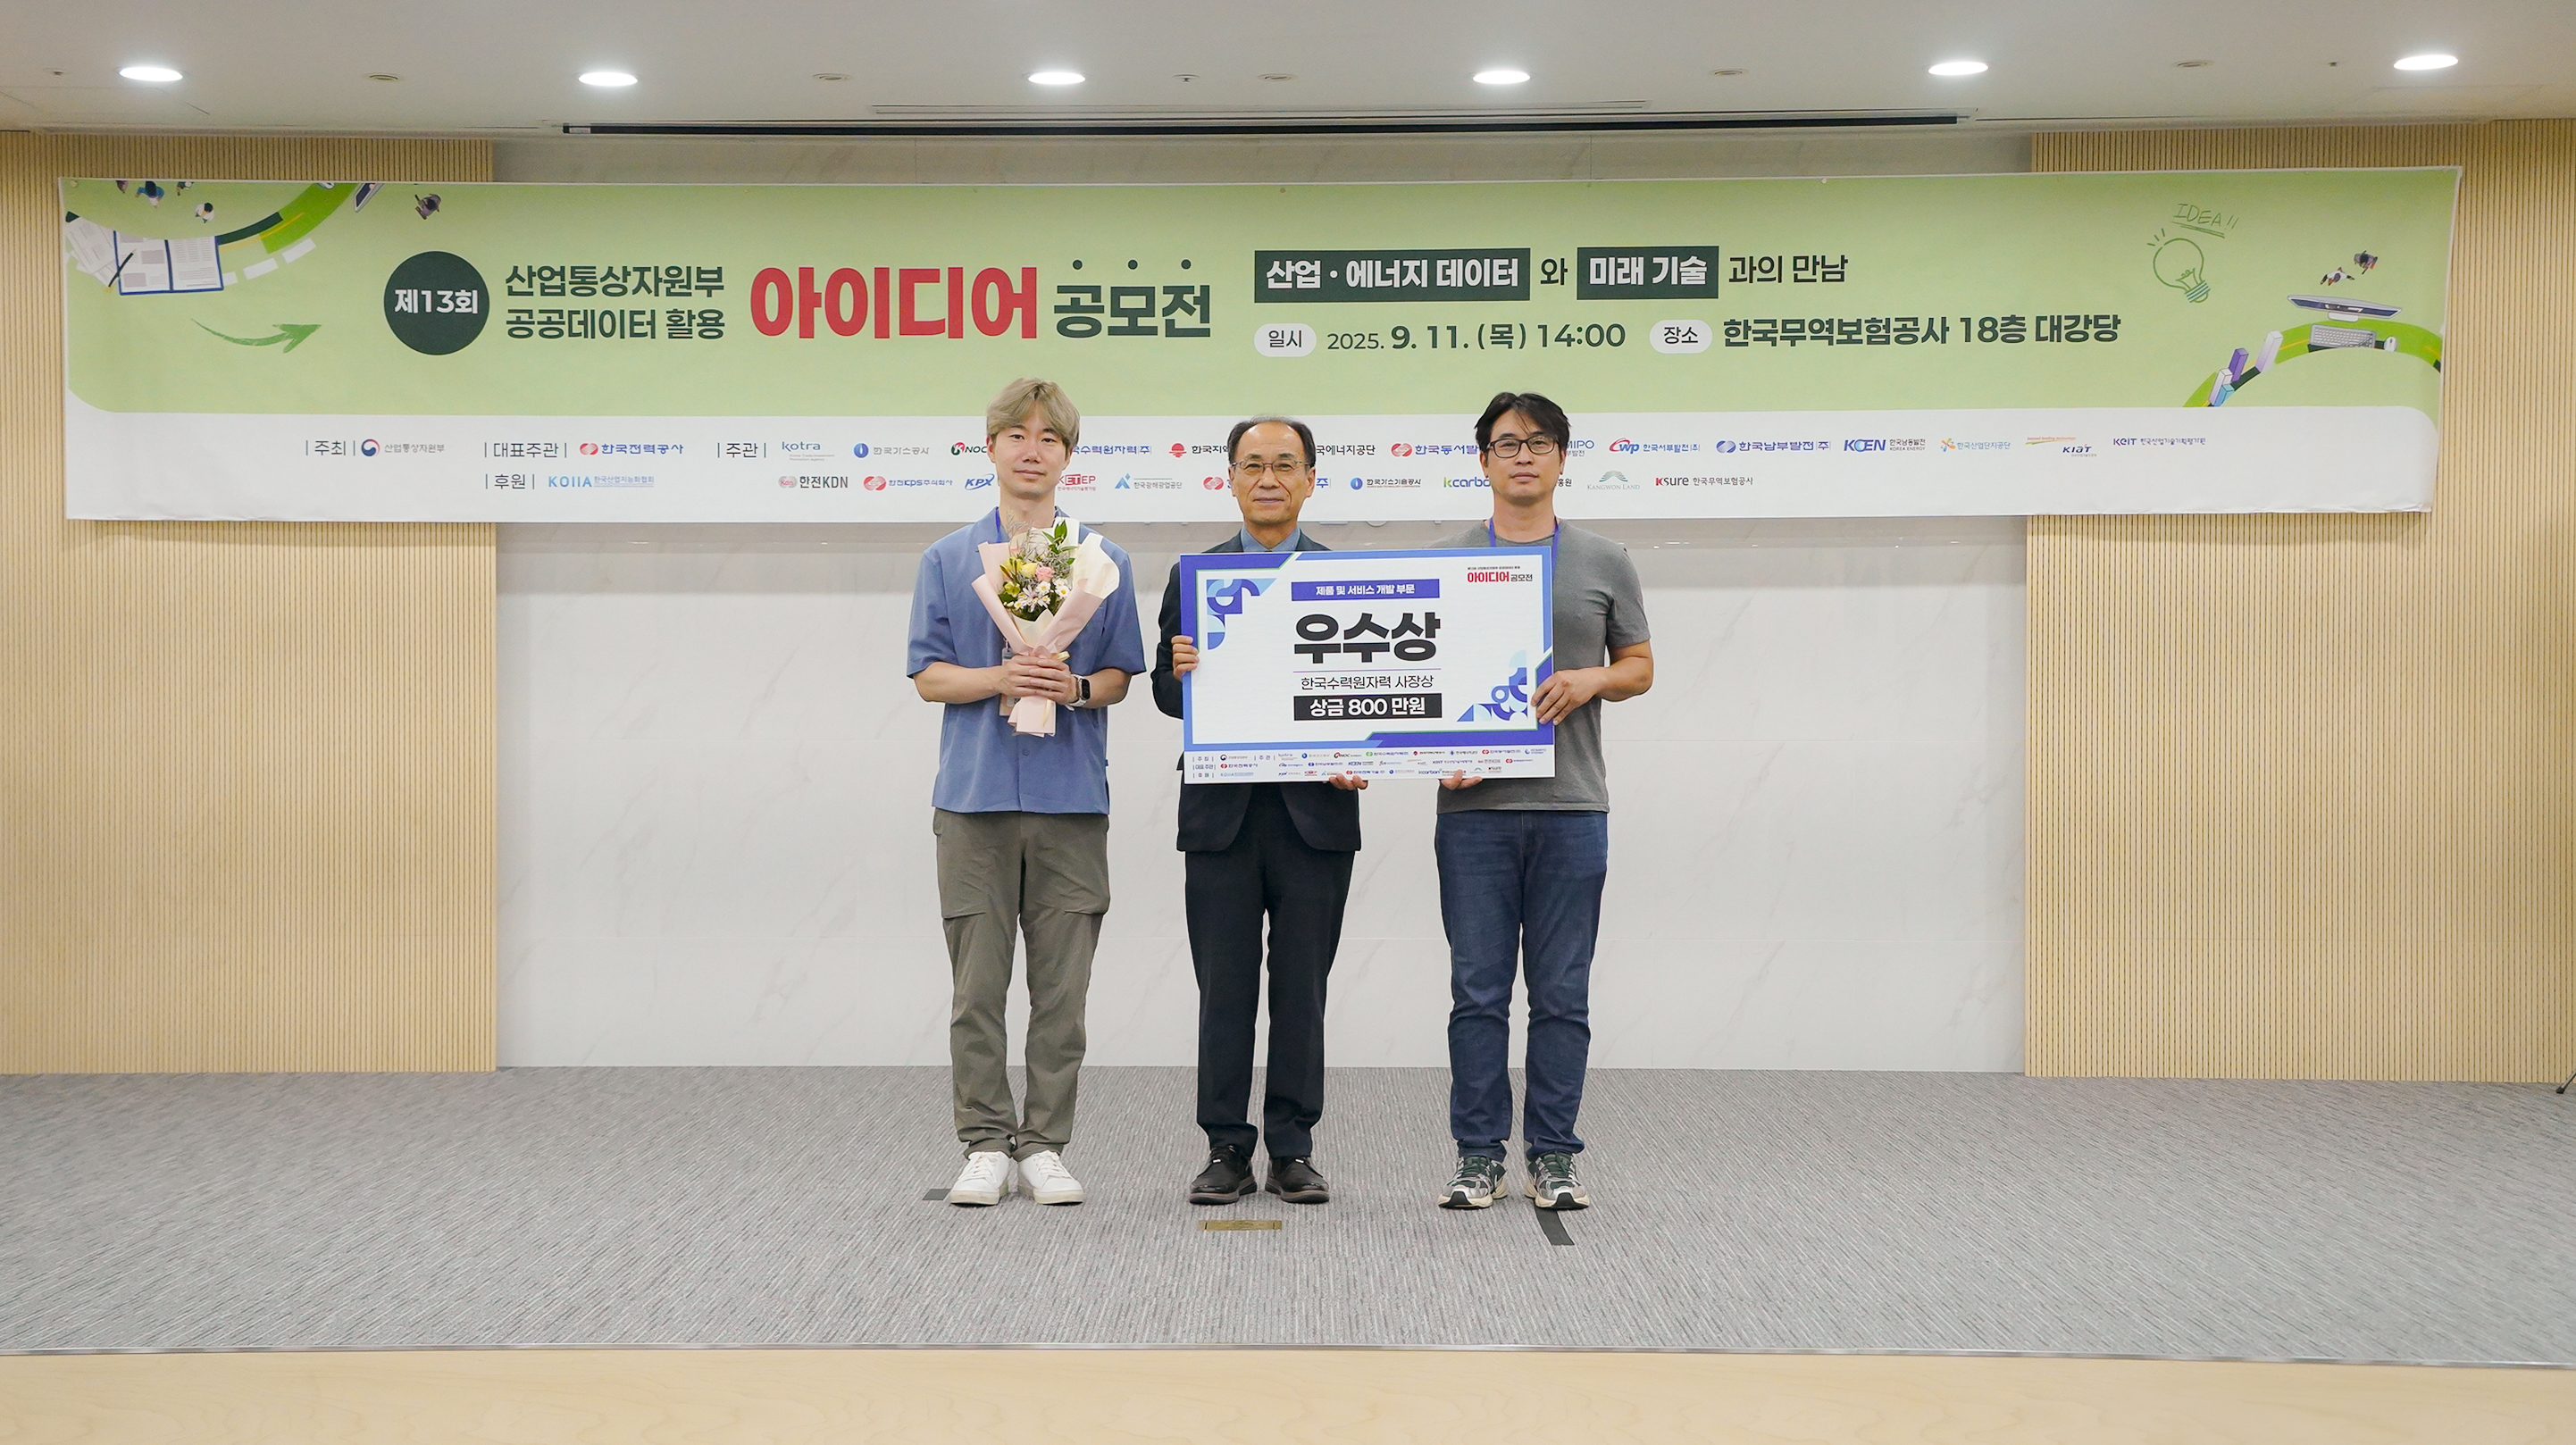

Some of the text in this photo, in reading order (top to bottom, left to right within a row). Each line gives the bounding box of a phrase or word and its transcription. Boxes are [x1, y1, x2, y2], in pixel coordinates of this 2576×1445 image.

[1266, 260, 1321, 290] 산업
[1345, 258, 1428, 289] 에너지
[1435, 256, 1518, 288] 데이터
[1540, 257, 1568, 286] 와
[1588, 255, 1708, 286] 미래 기술
[1728, 254, 1849, 284] 과의 만남
[505, 264, 724, 298] 산업통상자원부
[394, 288, 479, 314] 제13회
[749, 266, 1211, 339] 아이디어 공모전
[506, 308, 725, 340] 공공데이터 활용
[1723, 313, 2121, 347] 한국무역보험공사 18층 대강당
[1268, 330, 1302, 348] 일시
[1326, 322, 1627, 350] 2025. 9. 11. (목) 14:00
[1663, 326, 1699, 345] 장소
[314, 440, 347, 456] 주최
[384, 443, 445, 454] 산업통상자원부
[493, 442, 559, 458] 대표주관
[600, 444, 684, 455] 한국전력공사
[725, 442, 758, 458] 주관
[782, 441, 821, 452] kotra
[873, 447, 930, 455] 한국가스공사
[1956, 441, 2011, 450] 한국산업단지공단
[494, 473, 526, 489] 후원
[799, 475, 849, 489] 한전KDN
[1693, 477, 1754, 487] 한국무역보험공사
[1468, 572, 1510, 582] 아이디어
[1316, 586, 1334, 596] 제품
[1348, 585, 1375, 595] 서비스
[1376, 584, 1394, 595] 개발
[1396, 584, 1416, 594] 부문
[1293, 611, 1442, 664] 우수상
[1301, 675, 1434, 690] 한국수력원자력 사장상
[1309, 697, 1426, 717] 상금 800 만원
